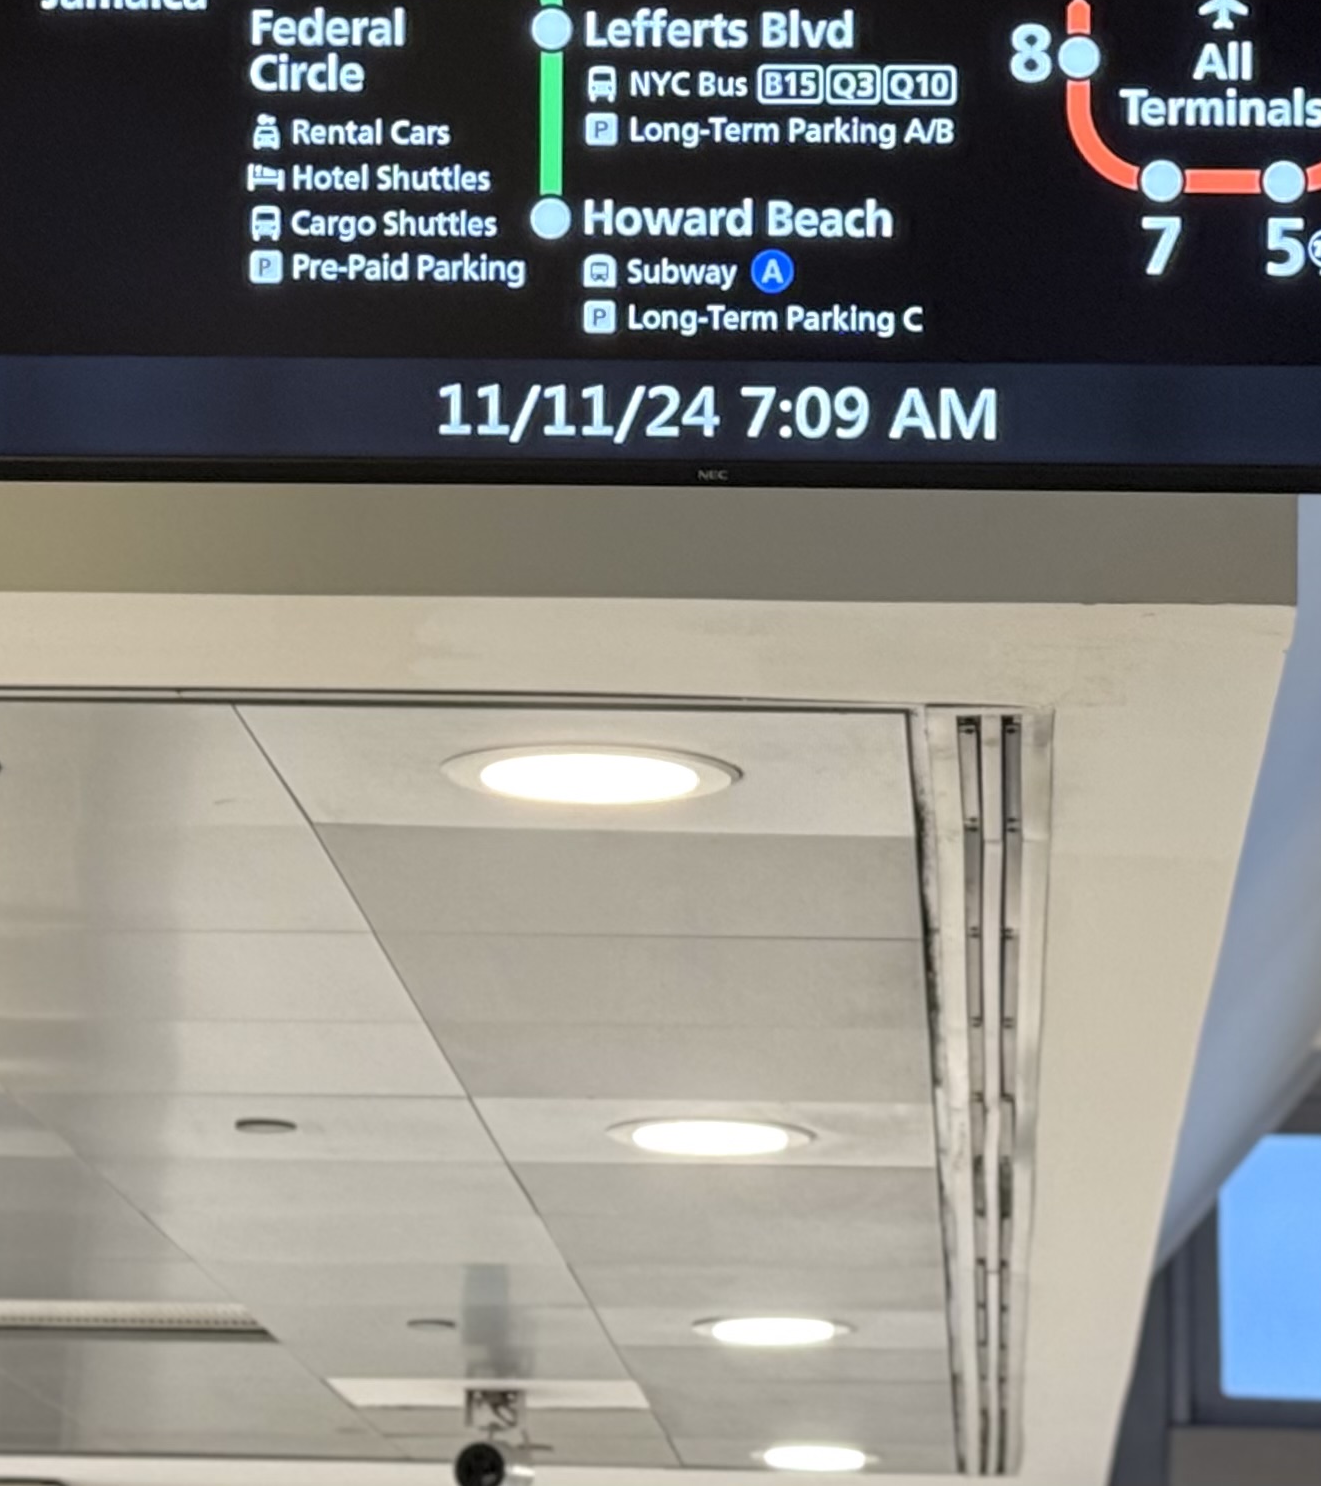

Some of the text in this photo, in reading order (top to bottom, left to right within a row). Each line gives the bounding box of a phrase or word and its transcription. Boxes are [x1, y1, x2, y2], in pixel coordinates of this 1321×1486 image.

[251, 6, 405, 47] Federal
[585, 7, 854, 49] Lefferts Blvd
[249, 52, 365, 92] Circle
[1010, 23, 1052, 83] 8
[1192, 40, 1253, 81] All
[630, 70, 950, 99] NYC Bus B15 Q3 Q10
[292, 118, 451, 146] Rental Cars
[630, 116, 780, 149] Long-Term
[788, 116, 897, 150] Parking
[903, 117, 954, 144] A/B
[292, 163, 491, 192] Hotel Shuttles
[290, 209, 498, 243] Cargo Shuttles
[583, 197, 893, 238] Howard Beach
[1141, 216, 1182, 275] 7
[1266, 217, 1305, 277] 5
[292, 252, 409, 281] Pre-Paid
[417, 252, 526, 289] Parking
[627, 257, 784, 291] Subway A
[628, 303, 778, 337] Long-Term
[786, 304, 895, 338] Parking
[902, 306, 923, 332] C
[438, 383, 997, 444] 11/11/24 7:09 AM
[697, 469, 729, 482] NEC
